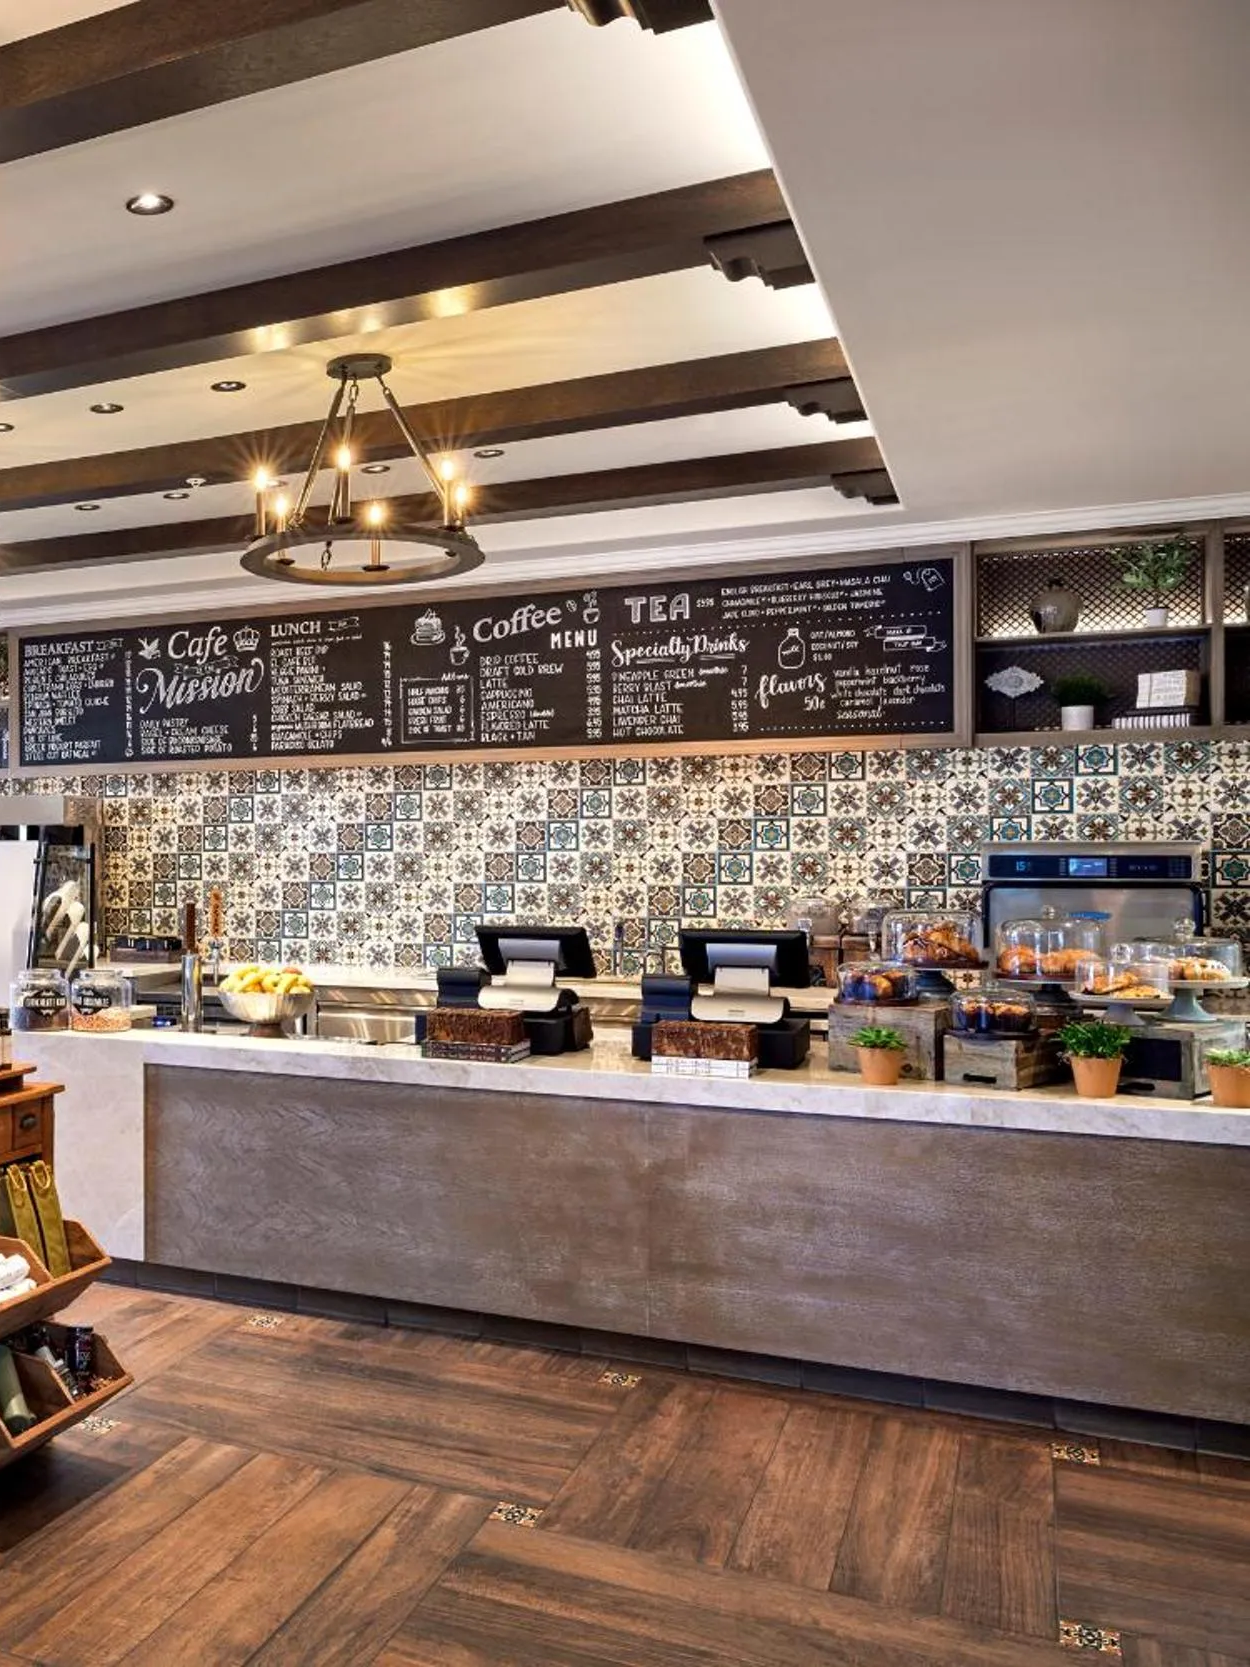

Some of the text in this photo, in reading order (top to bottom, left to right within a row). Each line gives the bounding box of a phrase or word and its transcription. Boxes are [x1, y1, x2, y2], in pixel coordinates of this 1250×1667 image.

[624, 593, 690, 624] TEA
[271, 621, 321, 637] LUNCH
[472, 603, 562, 642] Coffee
[550, 628, 598, 649] MENU
[24, 640, 94, 657] BREAKFAST
[168, 626, 228, 665] Cafe
[611, 632, 750, 668] Specialty Drinks
[480, 653, 539, 666] DRIP COFFEE
[480, 666, 509, 678] DRAFT
[538, 663, 564, 674] BREW
[612, 670, 659, 681] PINEAPPLE
[664, 668, 694, 679] GREEN
[741, 664, 748, 675] 7
[833, 666, 860, 678] vanilla
[865, 663, 901, 676] hazelnut
[136, 657, 265, 714] Mission
[341, 681, 363, 691] SALAD
[480, 678, 508, 689] LATTE
[612, 683, 640, 693] BERRY
[644, 681, 672, 692] BLAST
[741, 676, 748, 686] 7
[754, 671, 828, 709] flavors
[854, 686, 887, 698] chocolate
[893, 684, 910, 696] dark
[913, 682, 946, 695] chocolate
[338, 691, 361, 701] SALAD
[480, 688, 533, 700] CAPPUCCINO
[612, 694, 634, 704] CHAI
[637, 692, 667, 703] LATTE
[481, 700, 534, 711] AMERICANO
[839, 696, 916, 707] caramel lavender
[333, 709, 355, 719] SALAD
[612, 705, 650, 715] MATCHA
[654, 703, 684, 714] LATTE
[836, 705, 882, 719] seasonal
[481, 710, 526, 722] ESPRESSO
[612, 715, 682, 727] LAVENDER CHAI
[524, 719, 550, 730] LATTE
[612, 724, 684, 737] HOT CHOCOLATE
[319, 729, 343, 739] CHIPS
[517, 731, 536, 740] TAN
